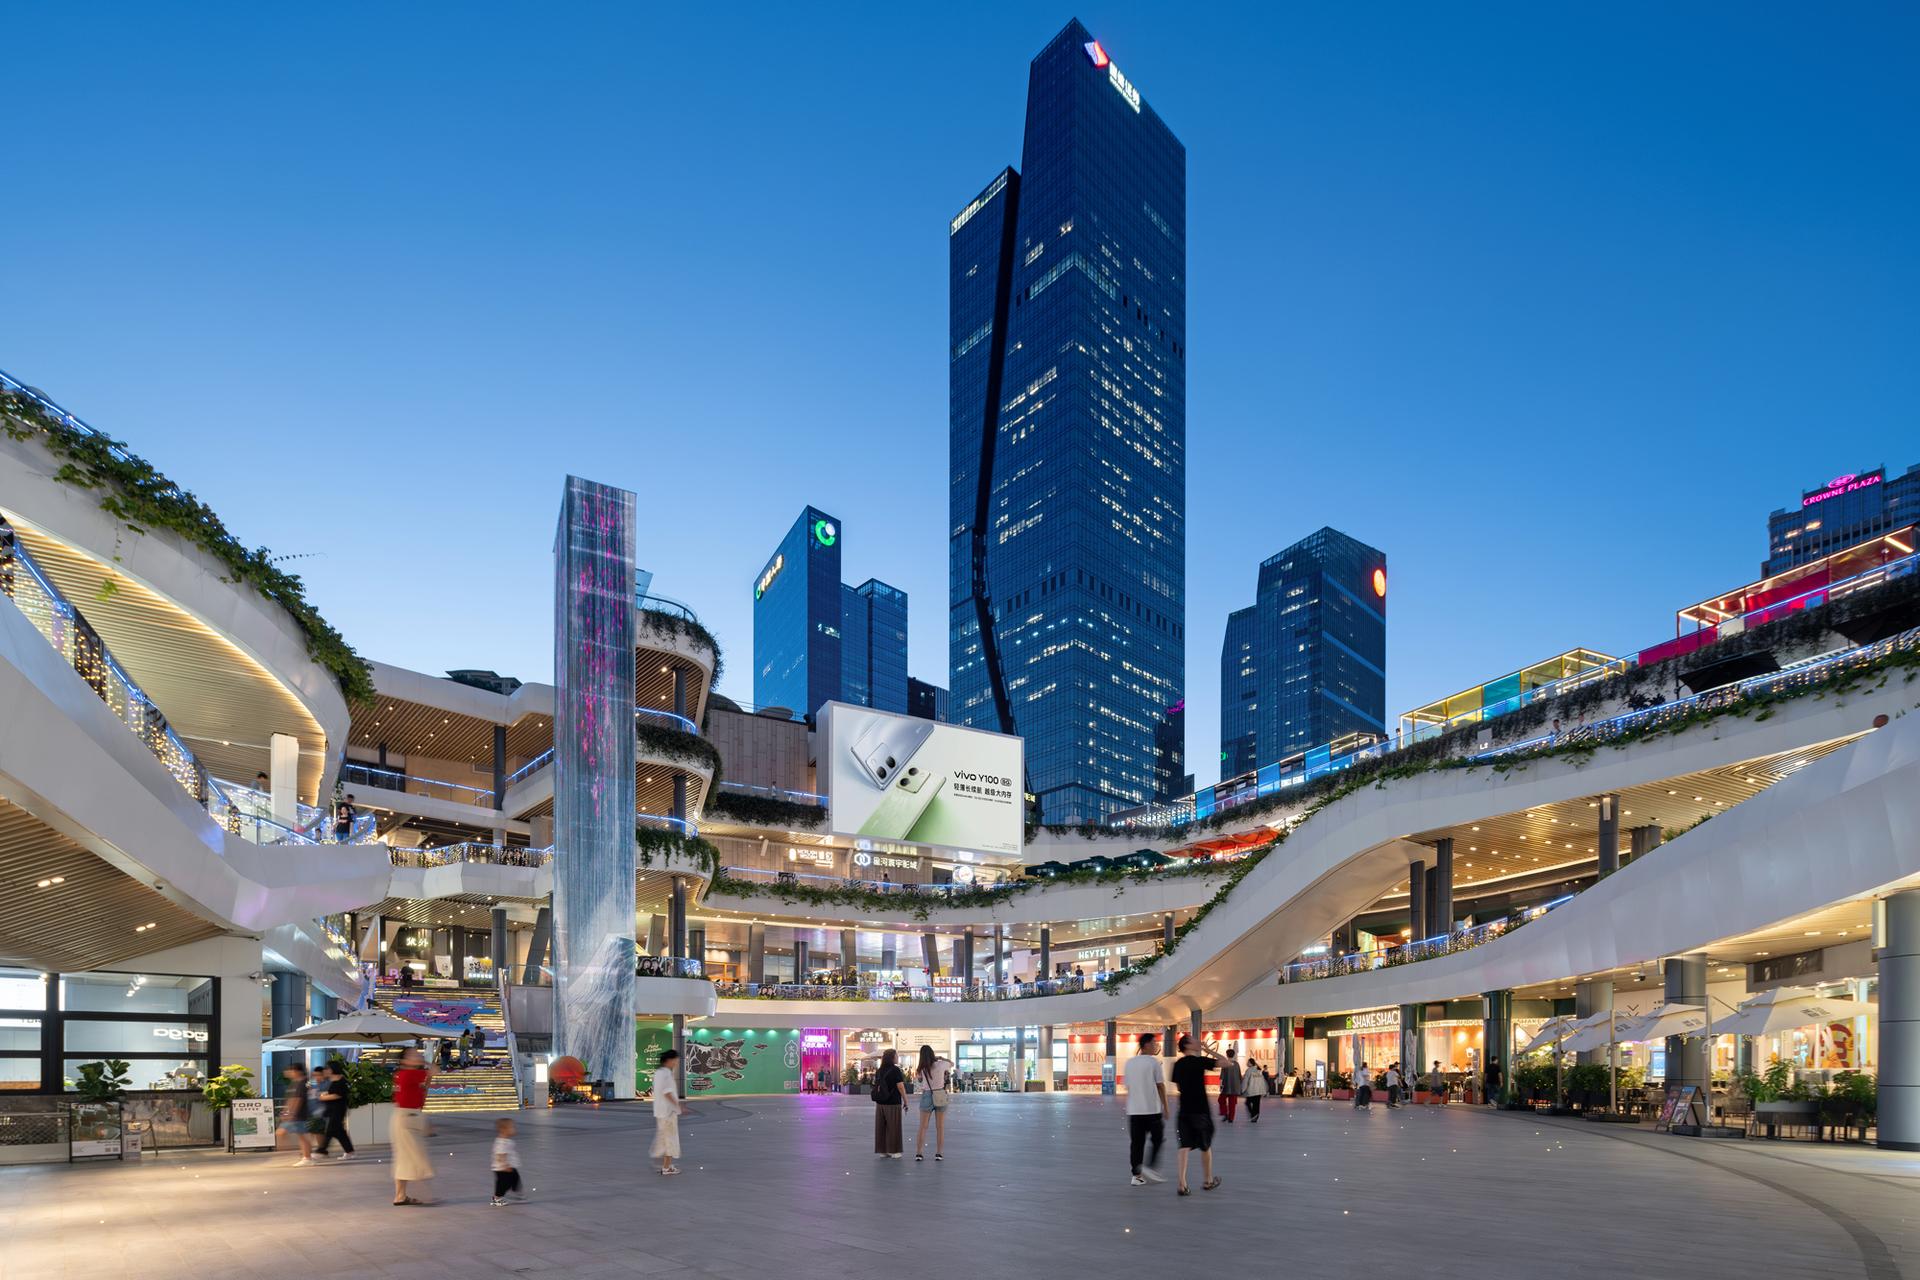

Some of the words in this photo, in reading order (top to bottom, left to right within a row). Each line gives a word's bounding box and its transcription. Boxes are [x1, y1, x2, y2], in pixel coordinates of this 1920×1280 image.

[1803, 488, 1845, 506] CROWNE
[1847, 474, 1882, 492] PLAZA
[954, 770, 977, 781] vivo
[978, 774, 999, 785] Y100
[1078, 948, 1111, 960] HEYTEA
[1352, 1013, 1376, 1029] SHAKE
